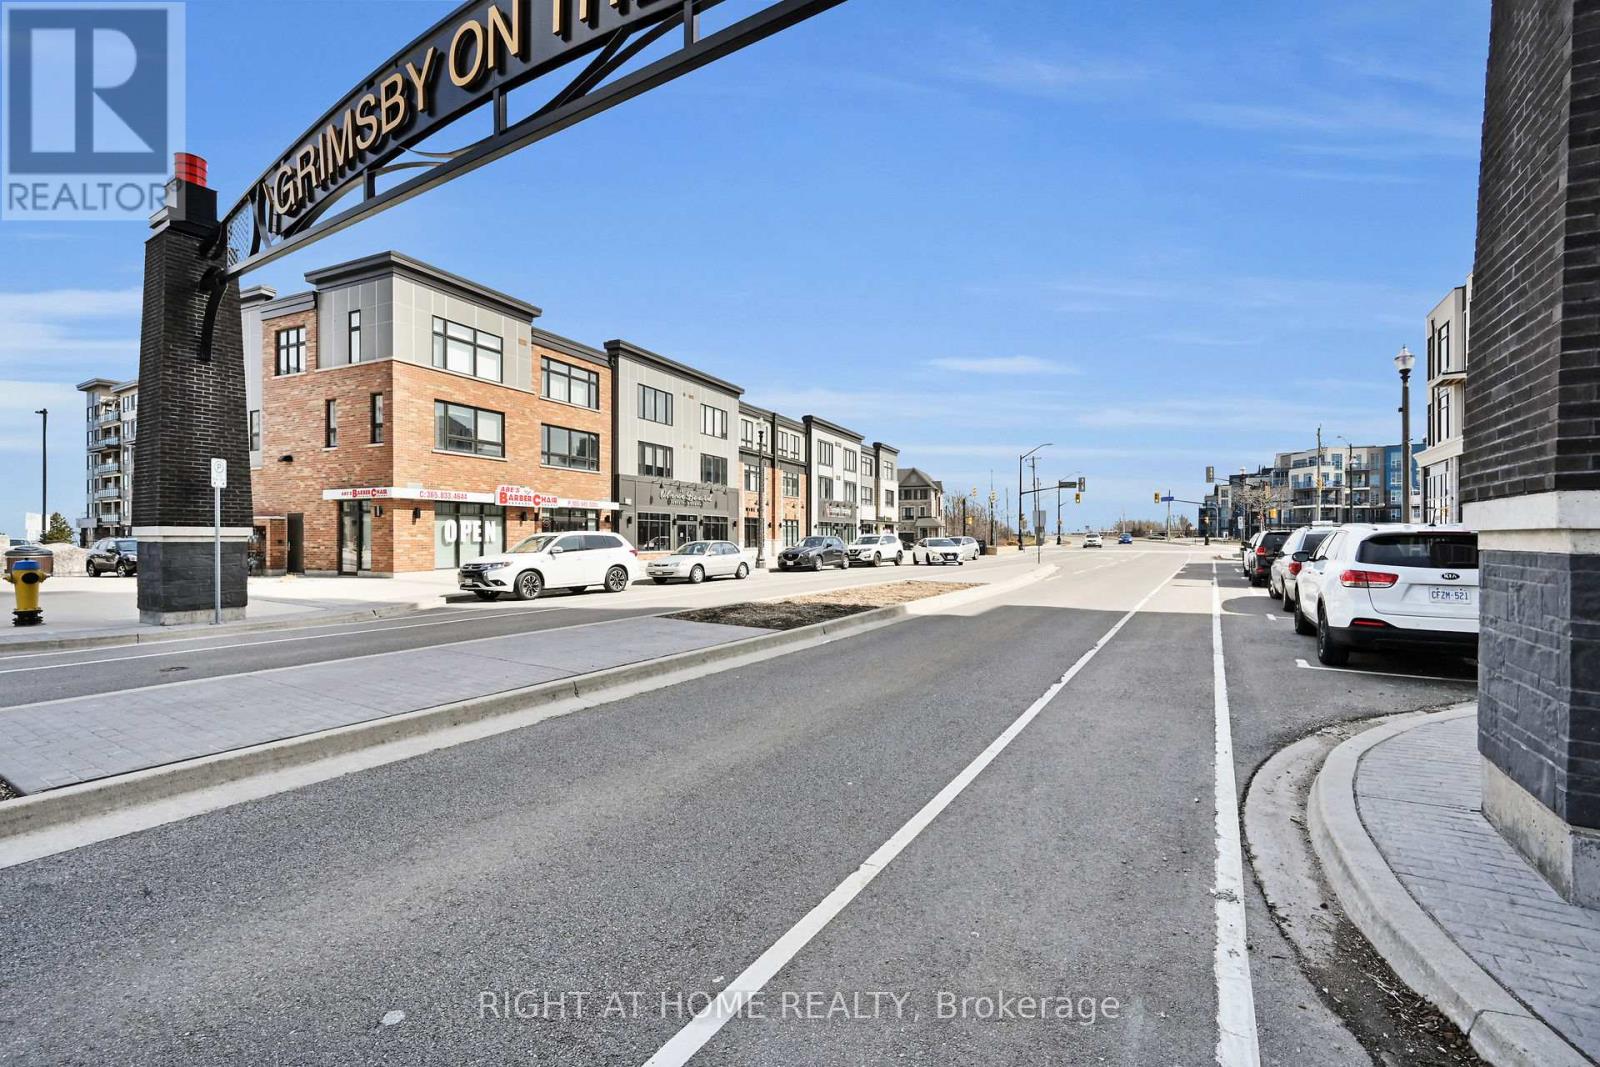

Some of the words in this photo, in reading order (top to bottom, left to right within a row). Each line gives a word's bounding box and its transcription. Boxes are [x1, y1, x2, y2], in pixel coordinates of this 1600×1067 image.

[274, 46, 437, 214] GRIMSBY
[448, 0, 520, 87] ON
[499, 492, 532, 504] BARBER
[533, 494, 558, 506] CHAIR
[444, 519, 496, 542] OPEN
